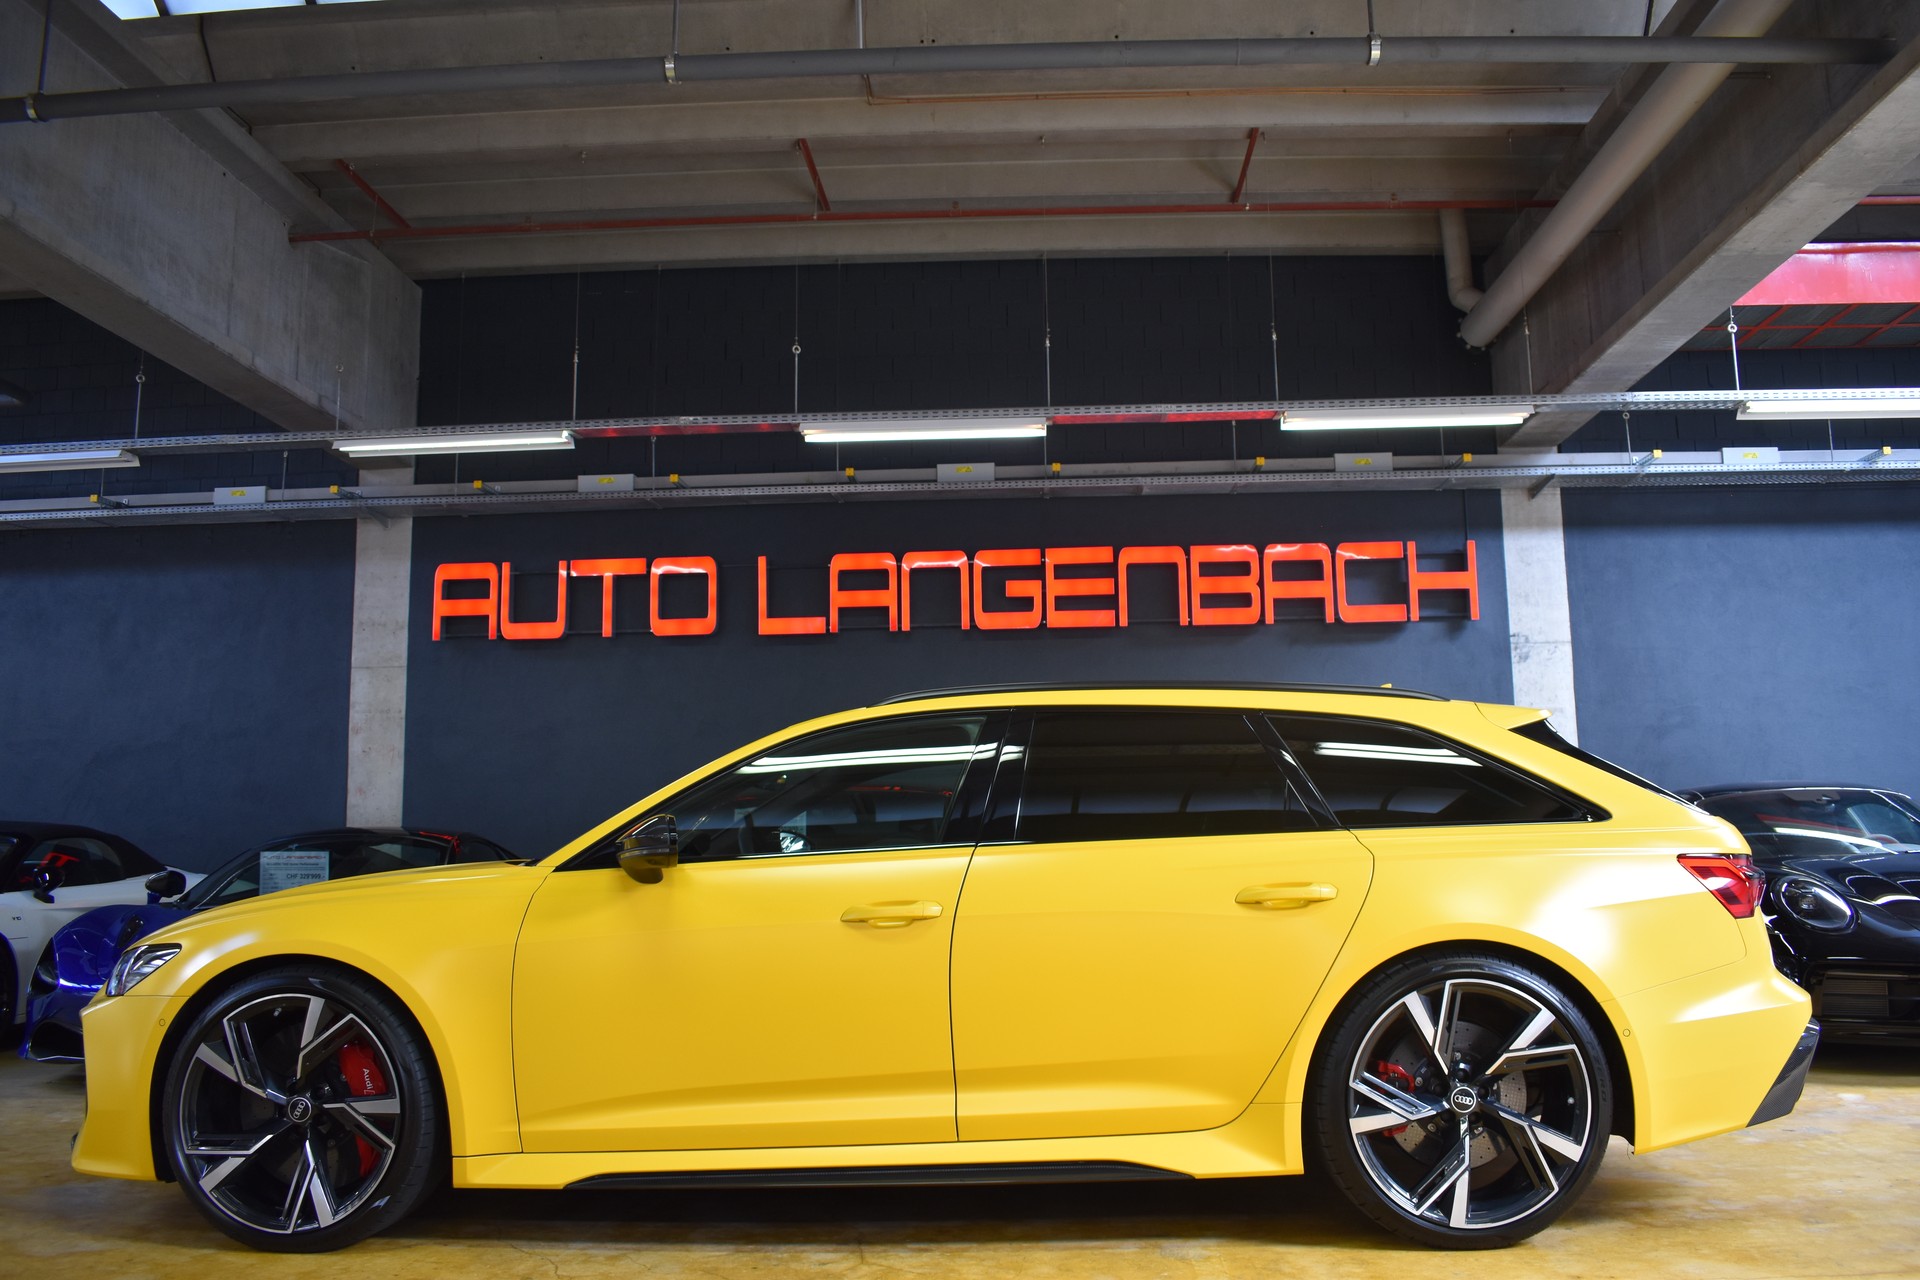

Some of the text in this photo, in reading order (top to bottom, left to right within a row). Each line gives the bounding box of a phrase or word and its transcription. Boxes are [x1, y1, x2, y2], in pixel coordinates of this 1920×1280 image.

[432, 539, 1480, 641] AUTO LANGENBACH
[362, 1068, 374, 1090] Audi
